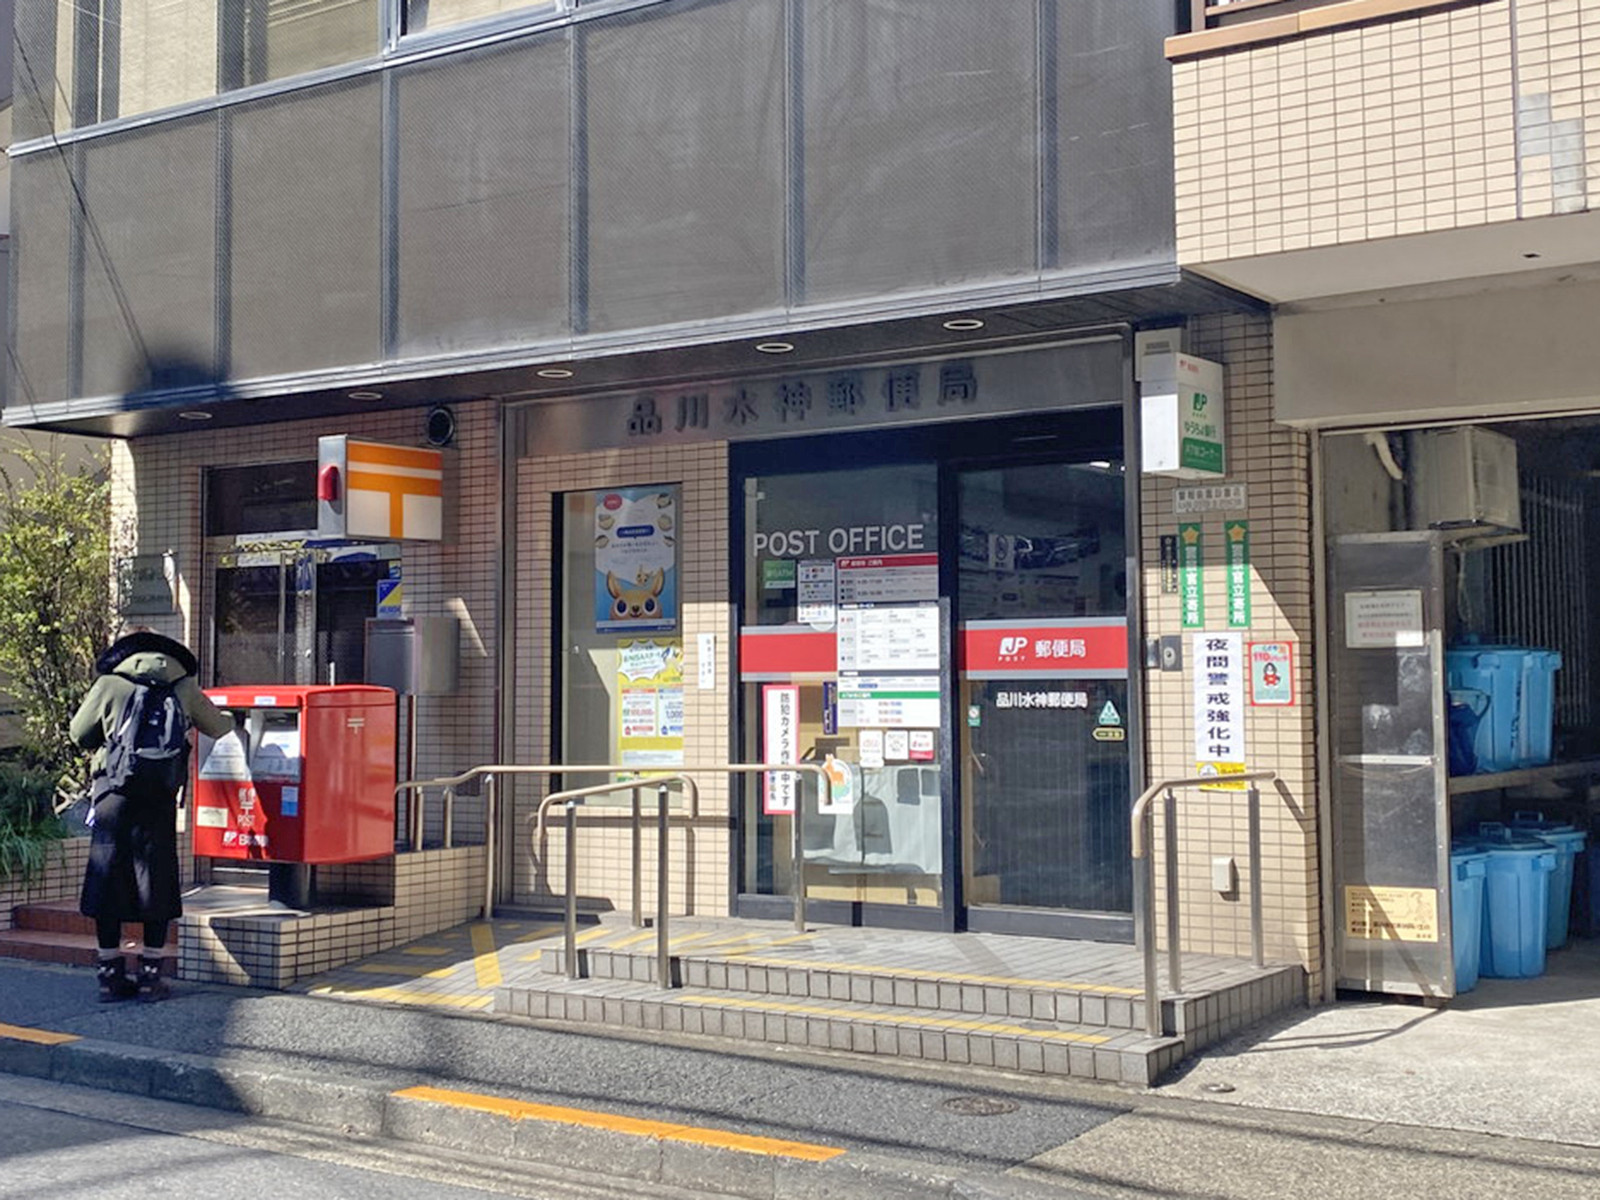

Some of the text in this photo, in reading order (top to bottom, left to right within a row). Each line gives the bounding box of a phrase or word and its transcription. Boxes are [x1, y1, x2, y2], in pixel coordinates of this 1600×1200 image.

[626, 361, 979, 436] 品川水神郵便局
[753, 524, 924, 557] POST OFFICE
[1035, 639, 1086, 658] 郵便局
[996, 692, 1088, 709] 品川水神郵便局
[1206, 638, 1231, 757] 夜間警戒強化中
